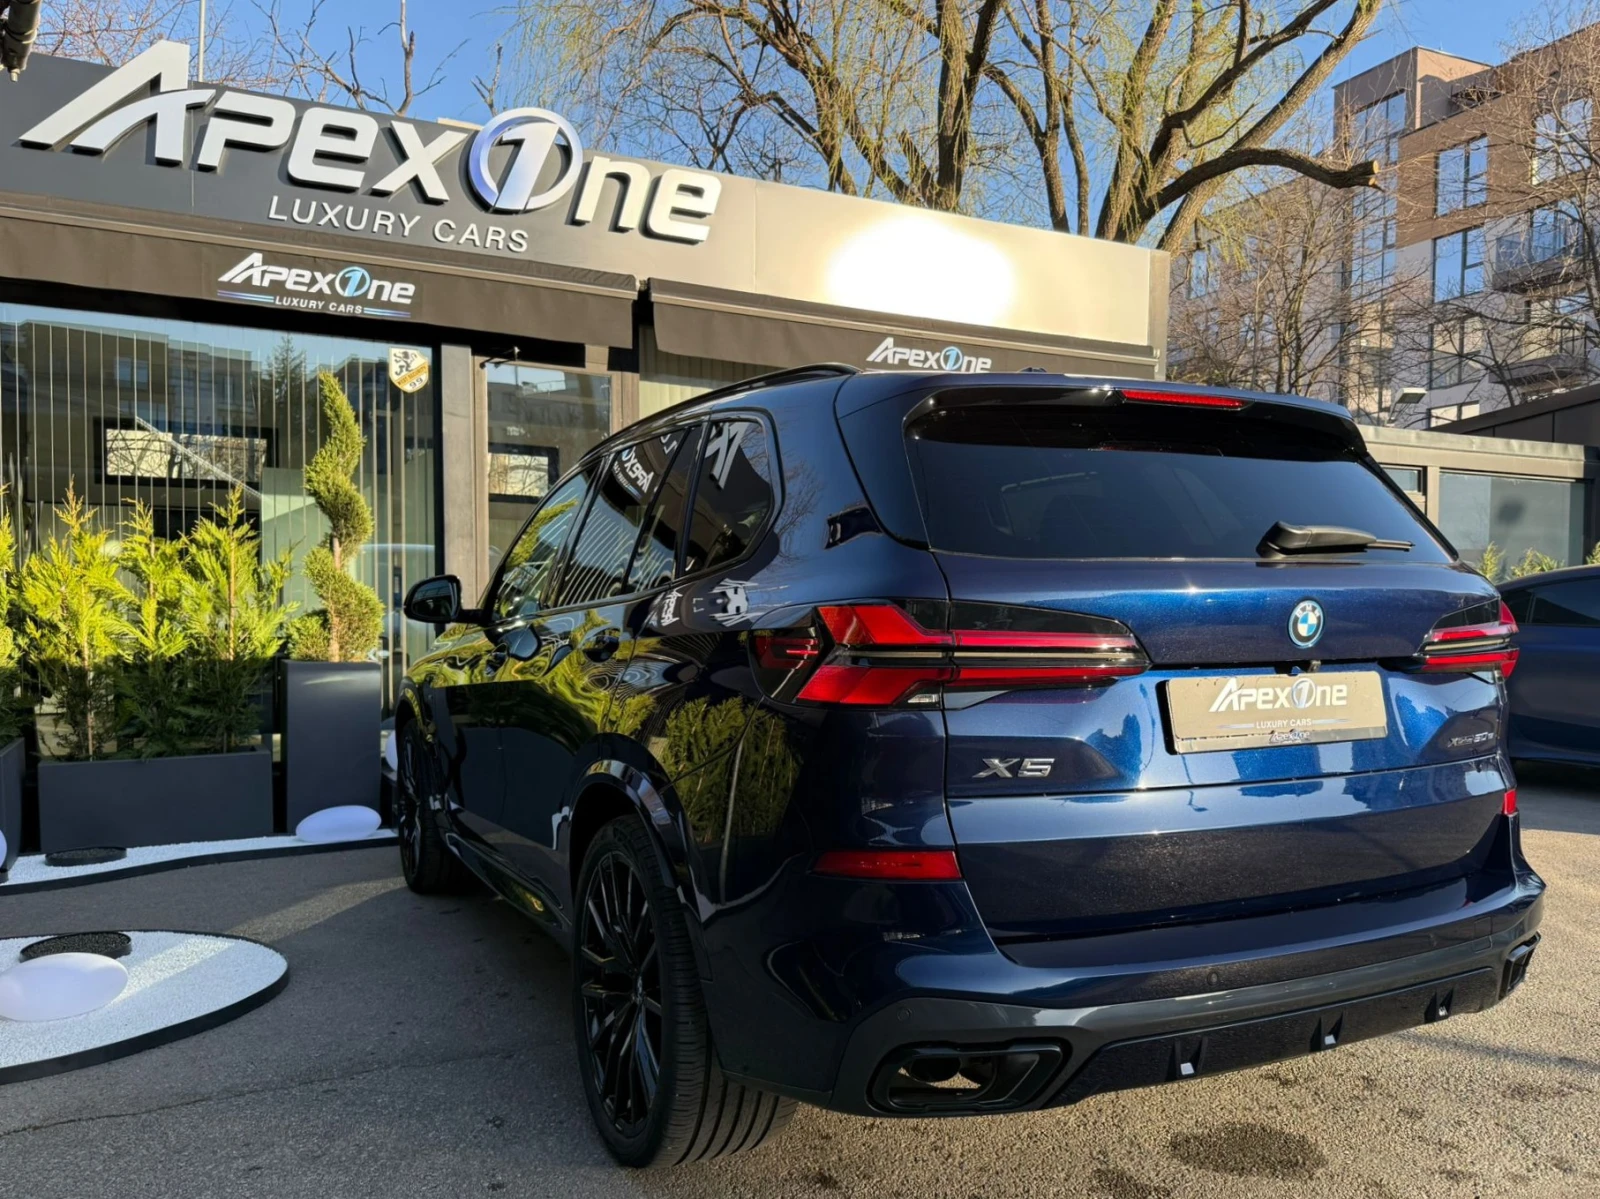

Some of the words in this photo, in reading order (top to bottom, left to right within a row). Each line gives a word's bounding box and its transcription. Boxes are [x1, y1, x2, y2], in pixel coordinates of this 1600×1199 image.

[268, 195, 421, 241] LUXURY
[433, 218, 530, 255] CARS
[274, 295, 325, 310] LUXURY
[328, 302, 363, 315] CARS
[1256, 719, 1288, 729] LUXURY
[1290, 718, 1312, 728] CARS
[972, 758, 1055, 778] X5
